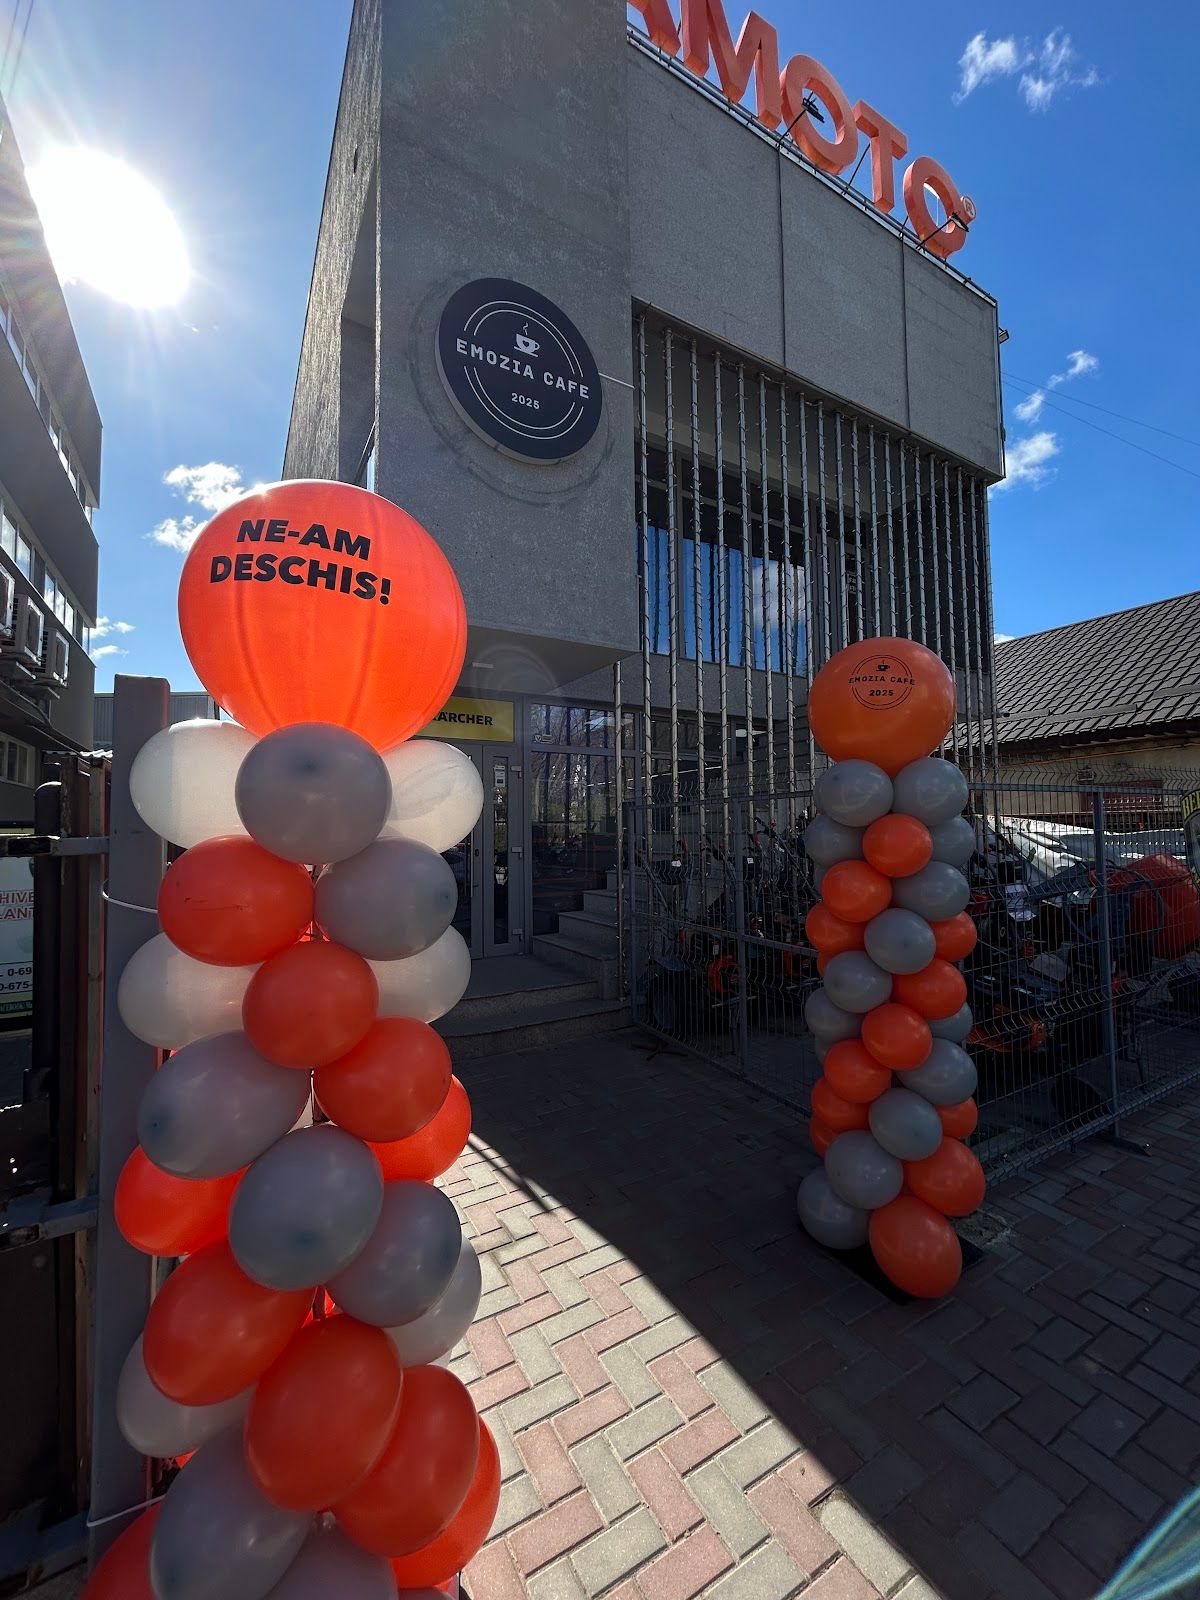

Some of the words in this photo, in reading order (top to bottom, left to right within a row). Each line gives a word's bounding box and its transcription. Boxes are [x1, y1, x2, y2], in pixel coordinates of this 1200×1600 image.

[456, 337, 534, 380] EMOZIA
[543, 371, 590, 399] CAFE
[511, 392, 540, 410] 2025
[236, 519, 371, 561] NE-AM
[210, 553, 392, 605] DESCHIS!
[848, 675, 886, 684] EMOZIA
[890, 676, 916, 685] CAFE
[868, 689, 894, 697] 2025
